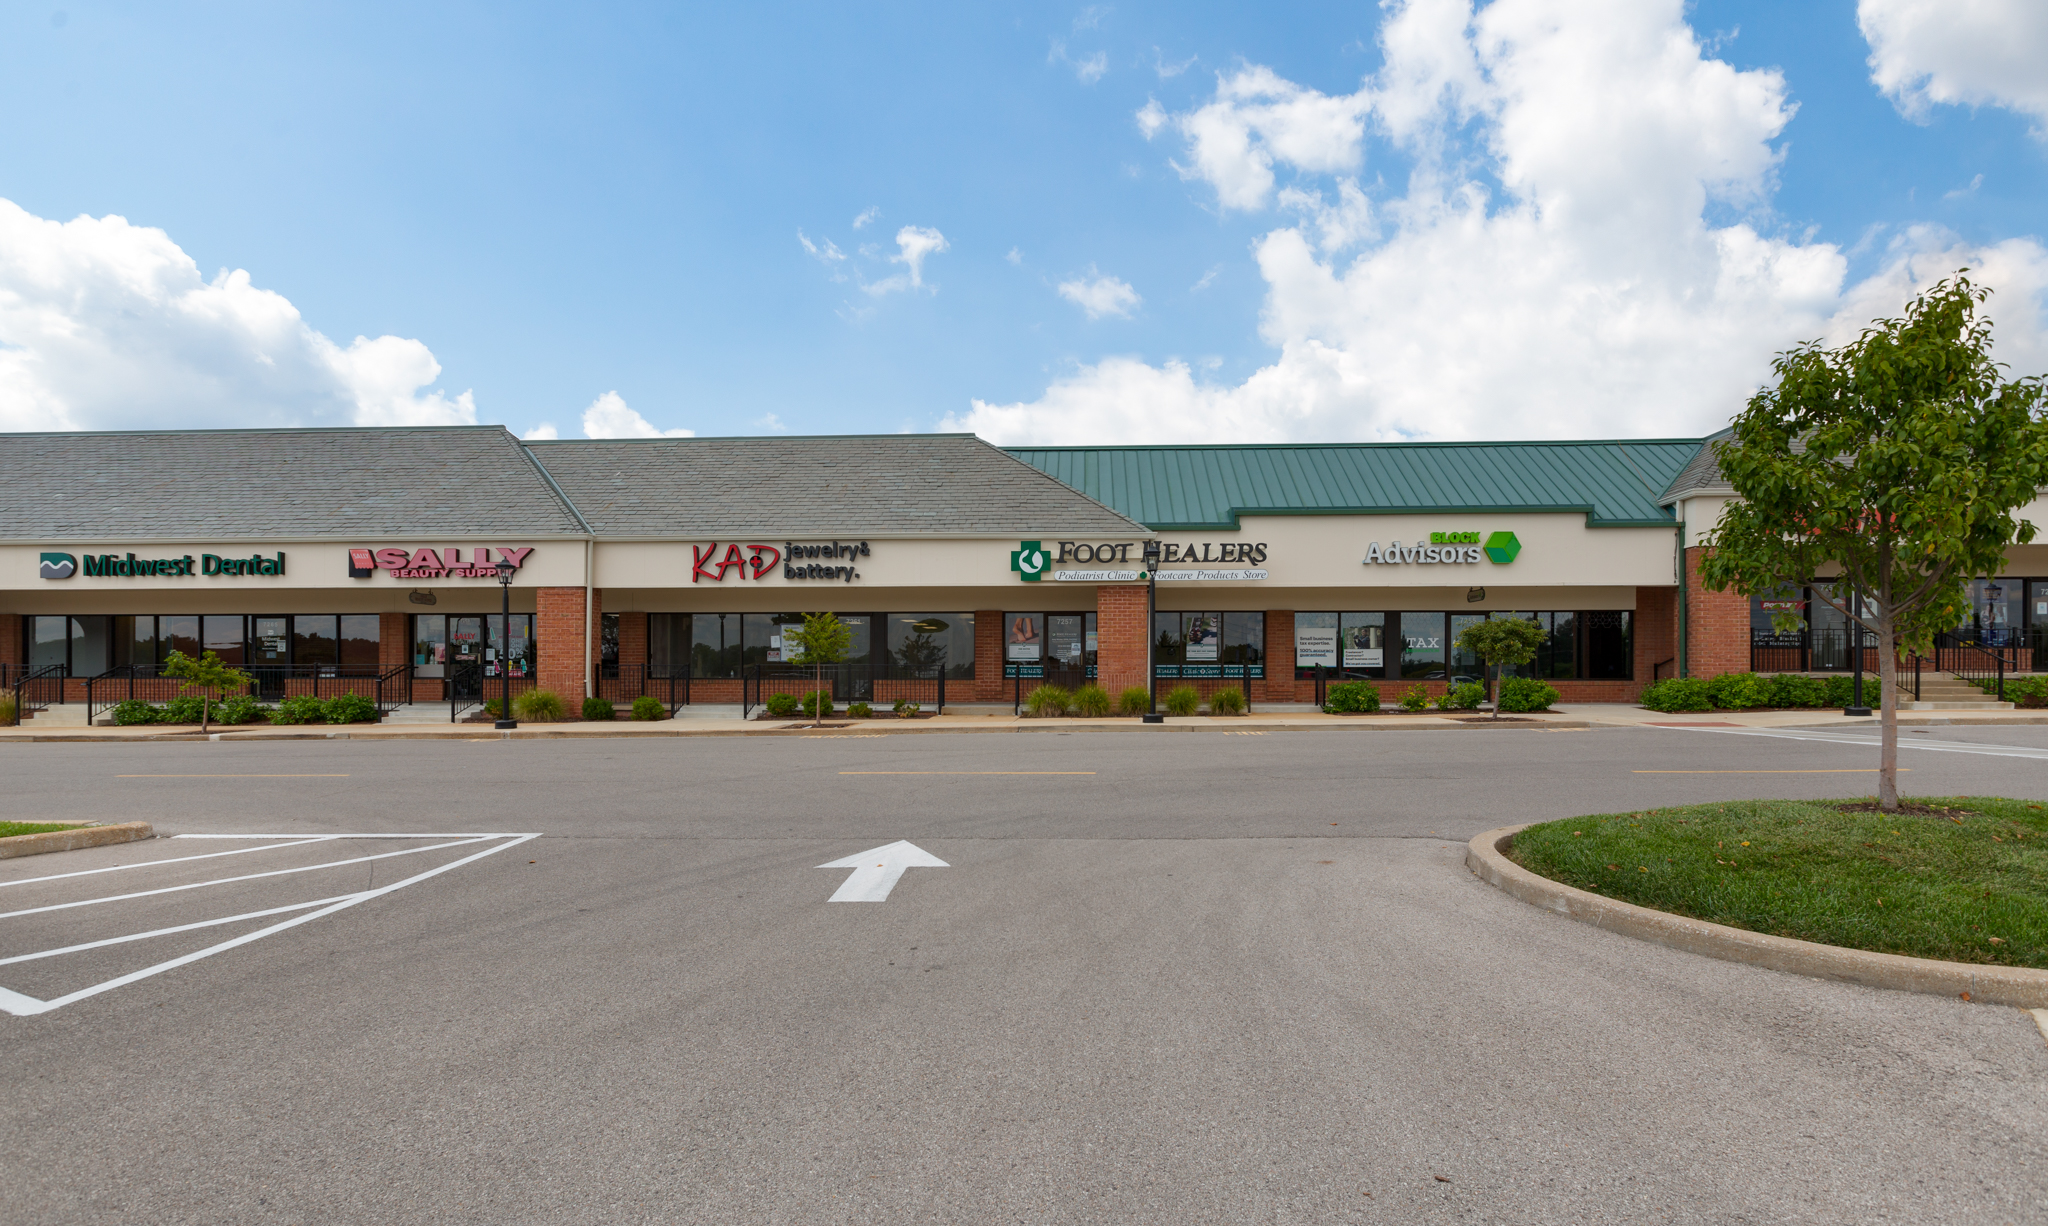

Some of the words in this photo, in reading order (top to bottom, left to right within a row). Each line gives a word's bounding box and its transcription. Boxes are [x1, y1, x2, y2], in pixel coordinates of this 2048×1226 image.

[1430, 532, 1480, 543] BLOCK
[375, 548, 534, 570] SALLY
[692, 542, 780, 583] KAD
[1056, 541, 1134, 564] FOOT
[1140, 541, 1268, 567] HEALERS
[1362, 541, 1482, 564] Advisors
[83, 552, 195, 576] Midwest
[202, 551, 286, 576] Dental
[390, 569, 450, 578] BEAUTY
[783, 563, 860, 582] battery.
[1058, 571, 1104, 580] Podiatrist
[1107, 571, 1136, 580] Clinic
[1196, 570, 1239, 580] Products
[1242, 570, 1267, 580] Store
[1406, 637, 1440, 648] TAX
